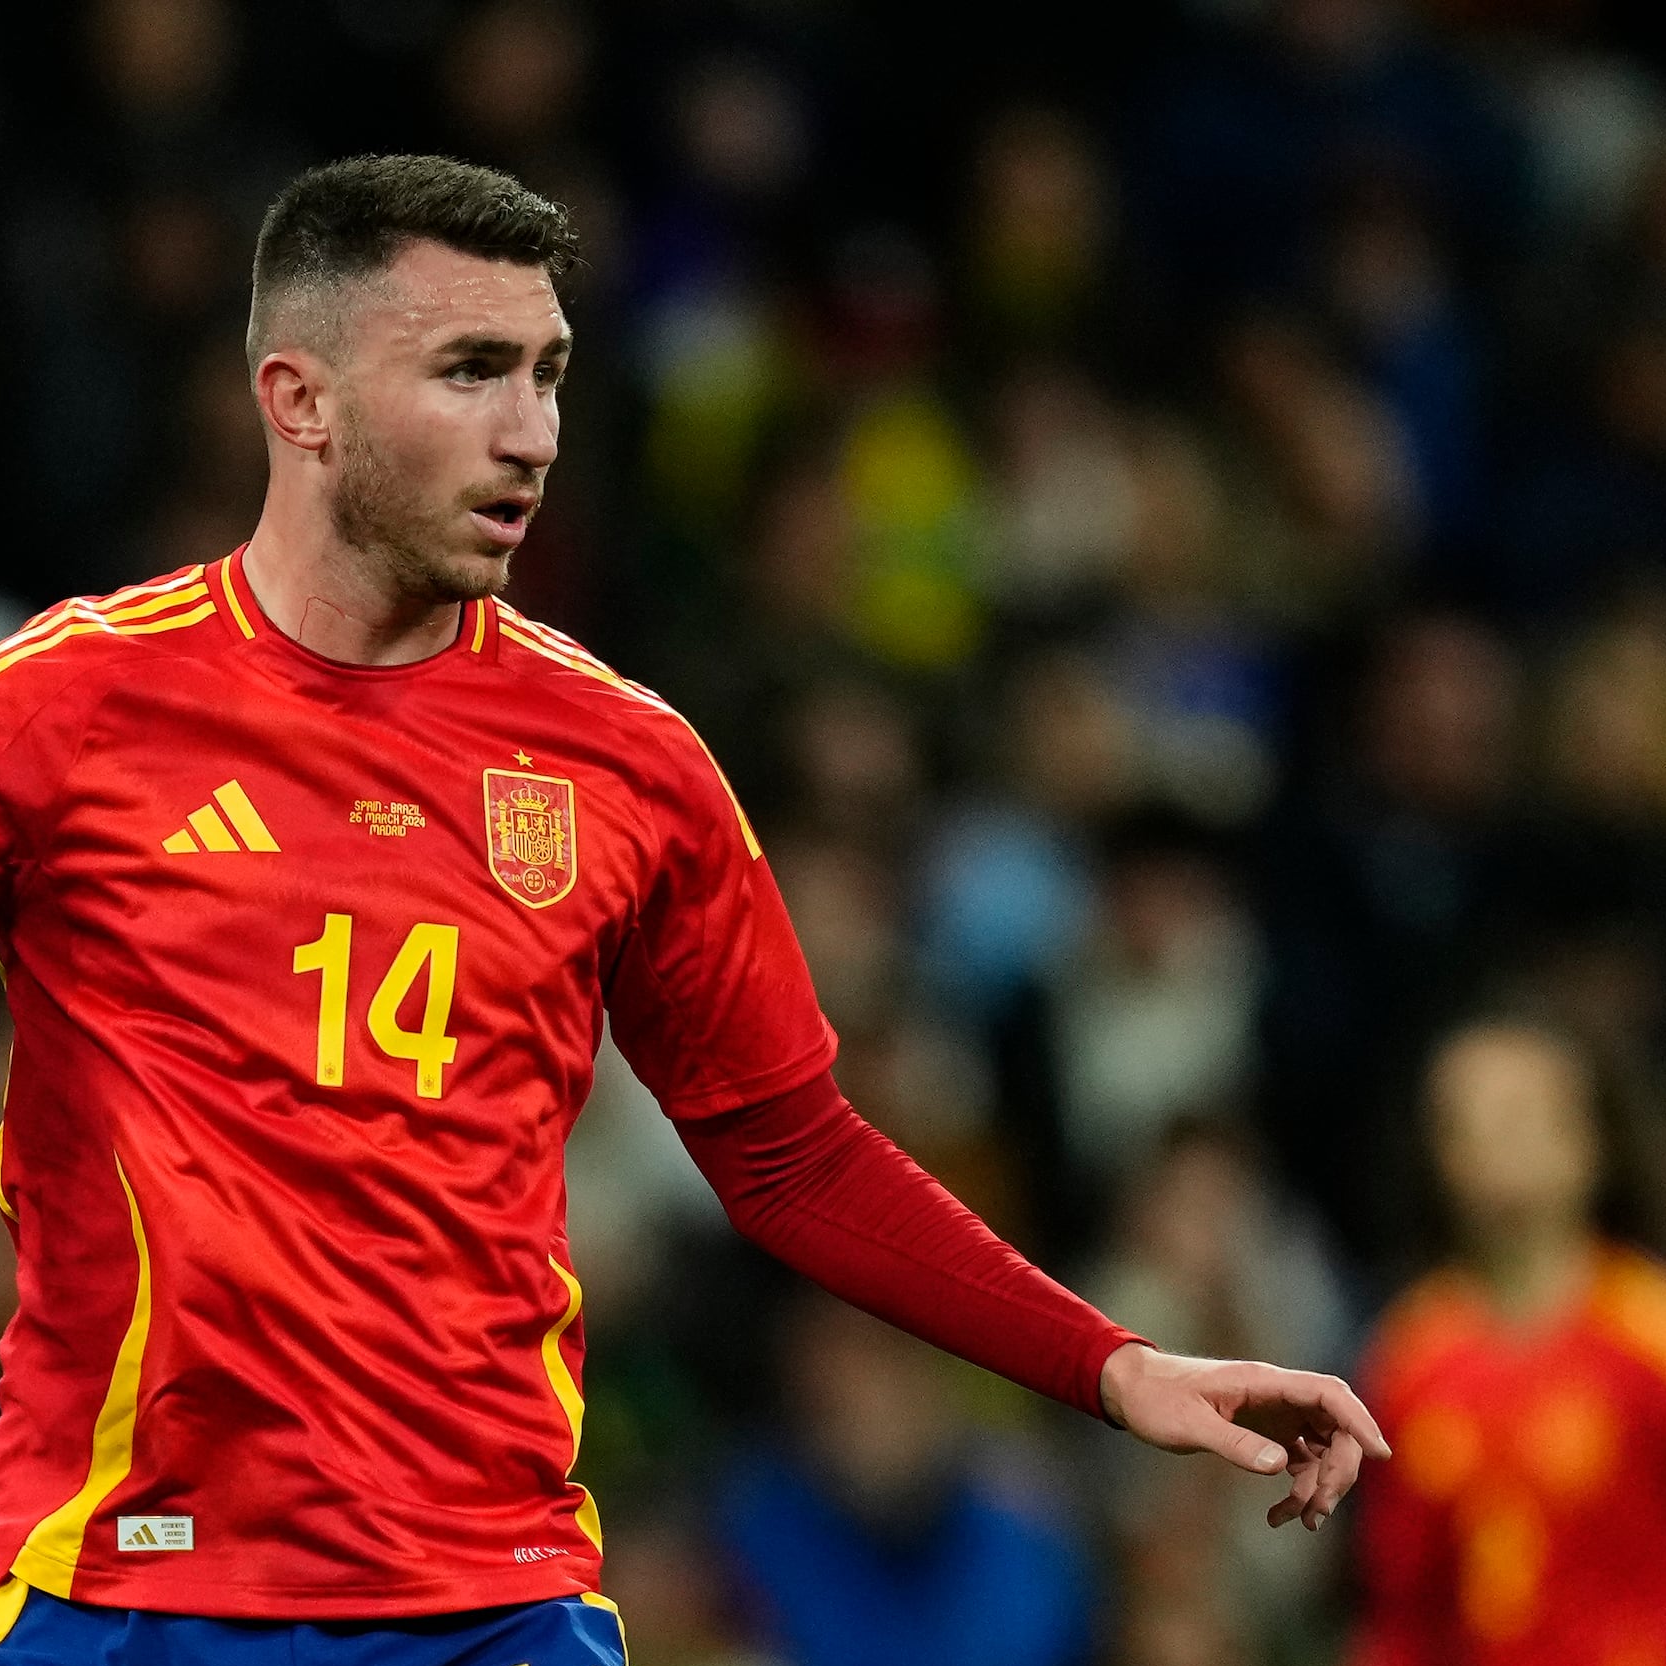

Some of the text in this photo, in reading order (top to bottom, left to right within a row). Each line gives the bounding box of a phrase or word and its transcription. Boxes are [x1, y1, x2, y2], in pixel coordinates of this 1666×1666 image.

[354, 800, 382, 812] SPAIN
[390, 802, 422, 816] BRAZIL
[349, 812, 426, 828] 26 MARCH 2024
[369, 824, 406, 837] MADRID
[293, 913, 459, 1099] 14
